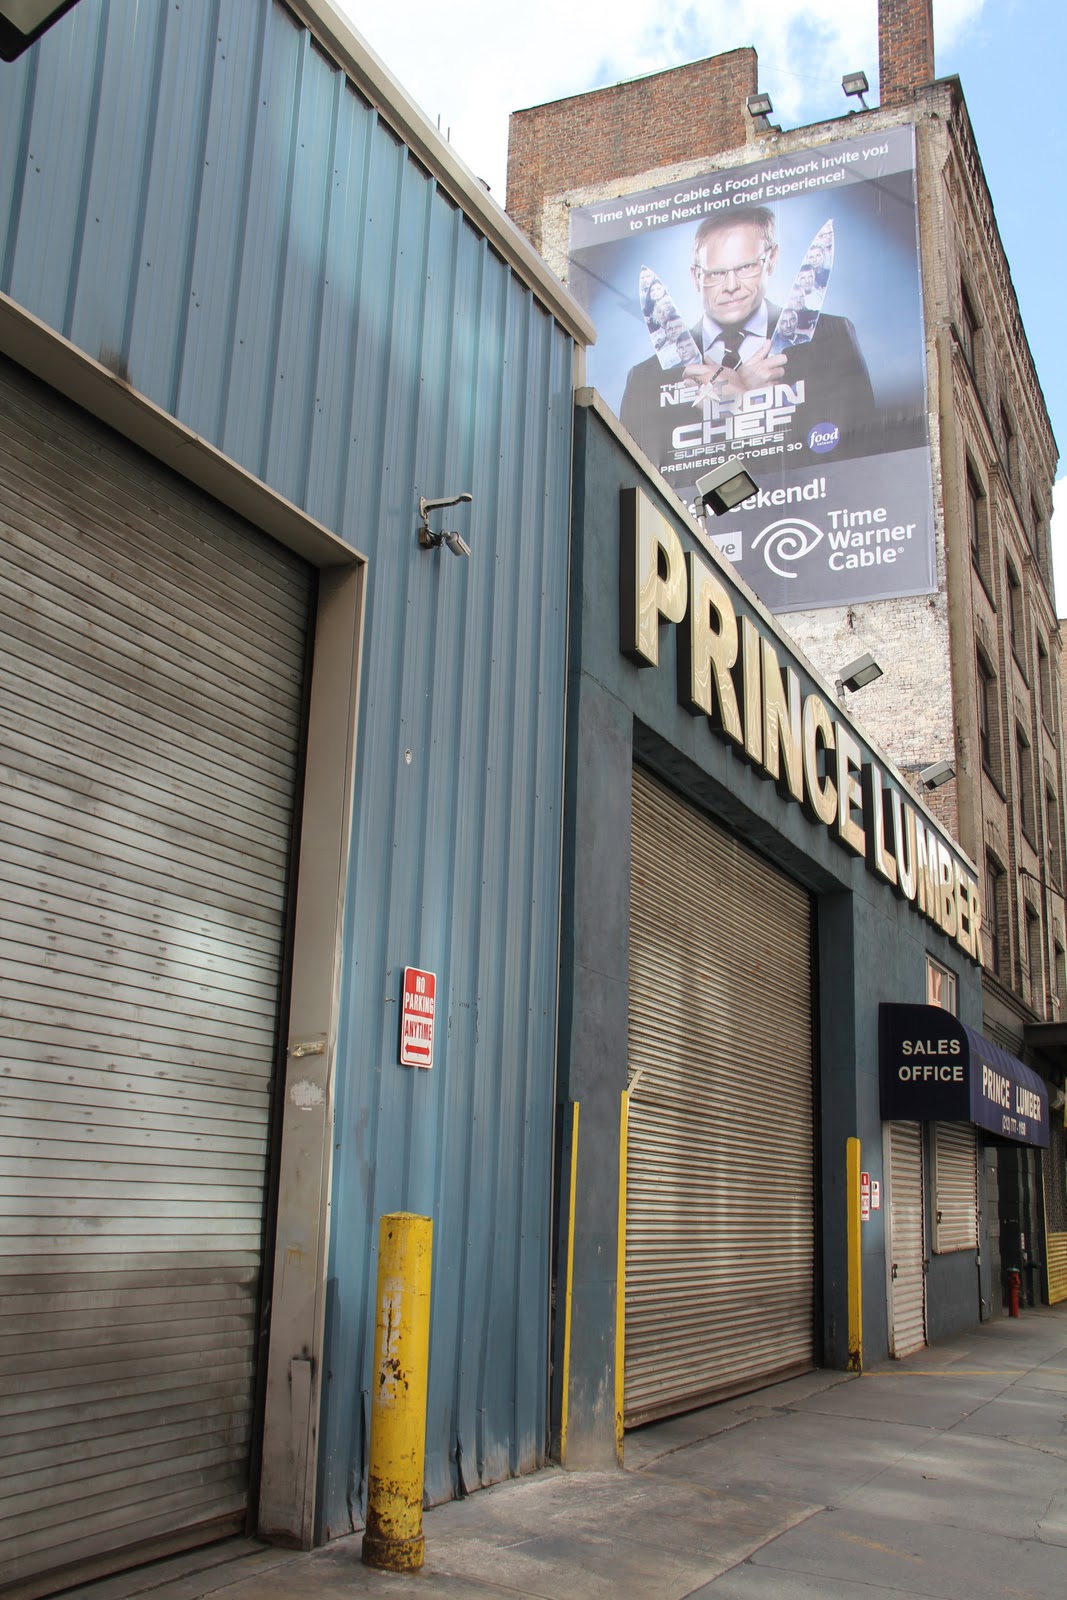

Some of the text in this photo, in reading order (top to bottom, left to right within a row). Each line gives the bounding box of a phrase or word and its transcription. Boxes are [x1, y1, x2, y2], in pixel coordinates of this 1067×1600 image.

[592, 144, 888, 225] Time Warner Cable & Food Network invite you
[629, 169, 845, 230] to The Next Iron Chef Experience!
[660, 381, 687, 392] THE
[702, 380, 806, 421] IRON
[672, 405, 796, 450] CHEF
[810, 428, 839, 448] food
[660, 442, 803, 474] PREMIERES OCTOBER 30
[674, 433, 784, 460] SUPER CHEFS
[827, 507, 887, 530] Time
[828, 522, 916, 551] Warner
[622, 486, 985, 967] PRINCE LUMBER
[415, 975, 426, 993] NO
[405, 992, 434, 1014] PARKING
[404, 1020, 432, 1041] ANYTIME
[902, 1039, 961, 1055] SALES
[898, 1066, 964, 1082] OFFICE
[982, 1064, 1042, 1122] PRINCE LUMBER
